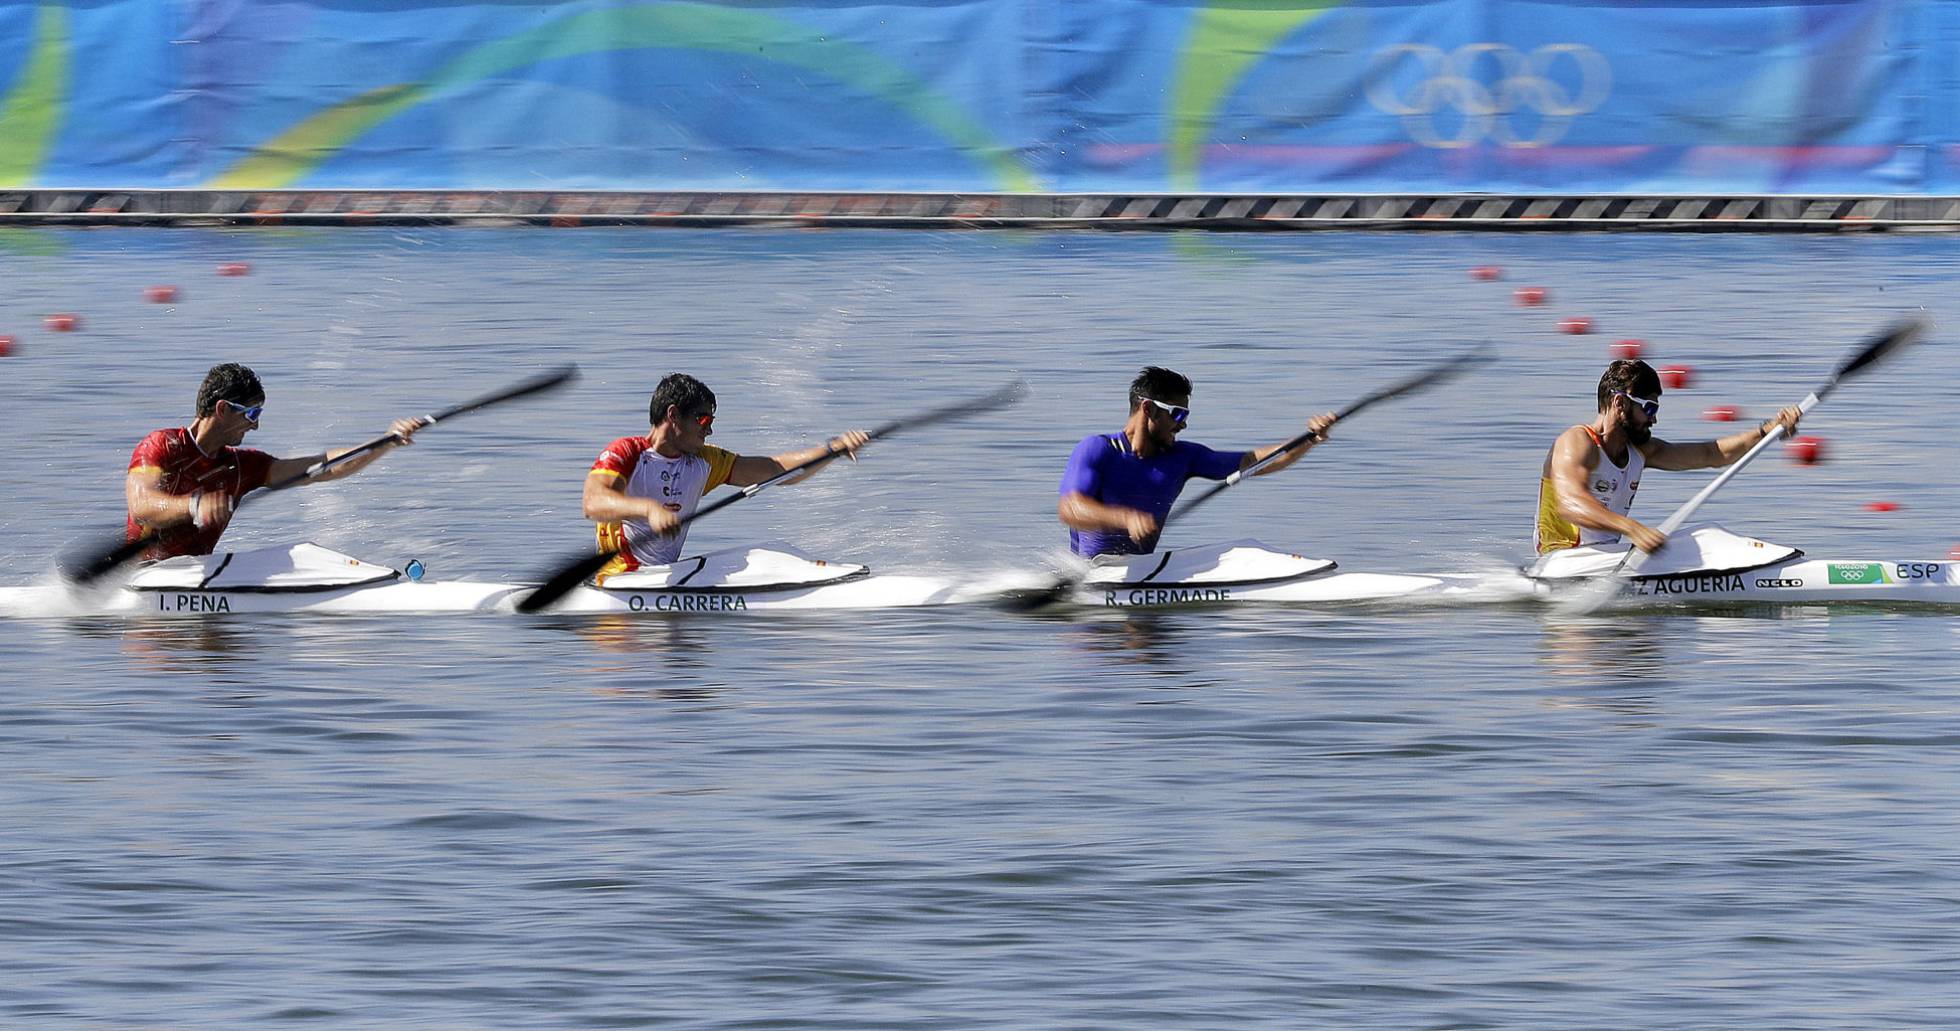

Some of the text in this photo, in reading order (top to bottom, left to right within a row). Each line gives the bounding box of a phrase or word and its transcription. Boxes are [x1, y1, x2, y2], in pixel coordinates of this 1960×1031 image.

[1896, 563, 1939, 579] ESP
[1654, 575, 1745, 594] AGUERIA
[160, 594, 230, 612] I. PENA
[628, 595, 747, 611] O. CARRERA
[1105, 589, 1231, 607] R. GERMADE
